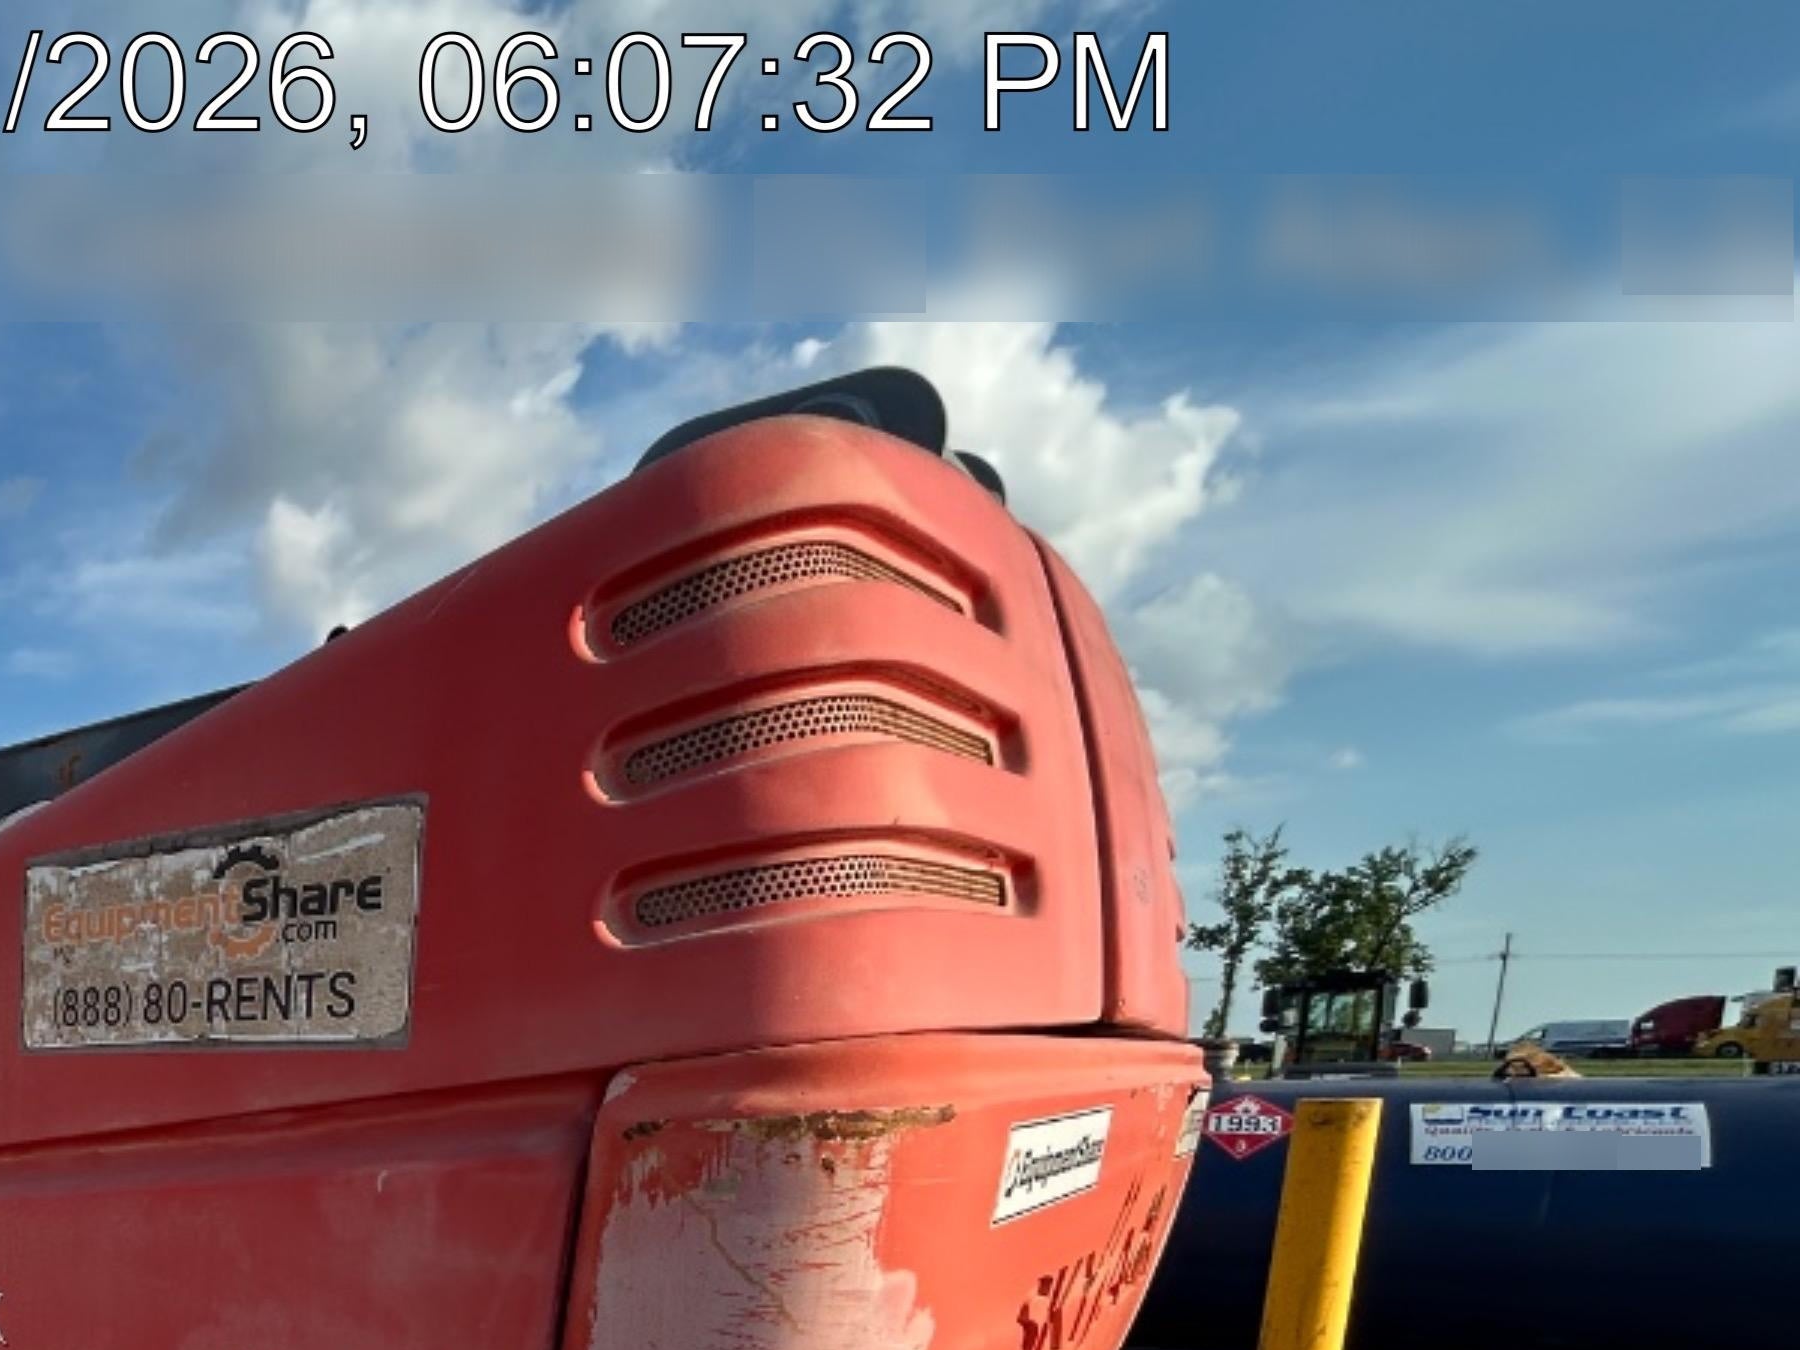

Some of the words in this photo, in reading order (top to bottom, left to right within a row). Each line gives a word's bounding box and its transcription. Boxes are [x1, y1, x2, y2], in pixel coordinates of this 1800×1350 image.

[43, 875, 383, 946] EquipmentShare
[275, 920, 338, 944] .com
[52, 980, 133, 1030] (888)
[143, 971, 357, 1026] 80-RENTS
